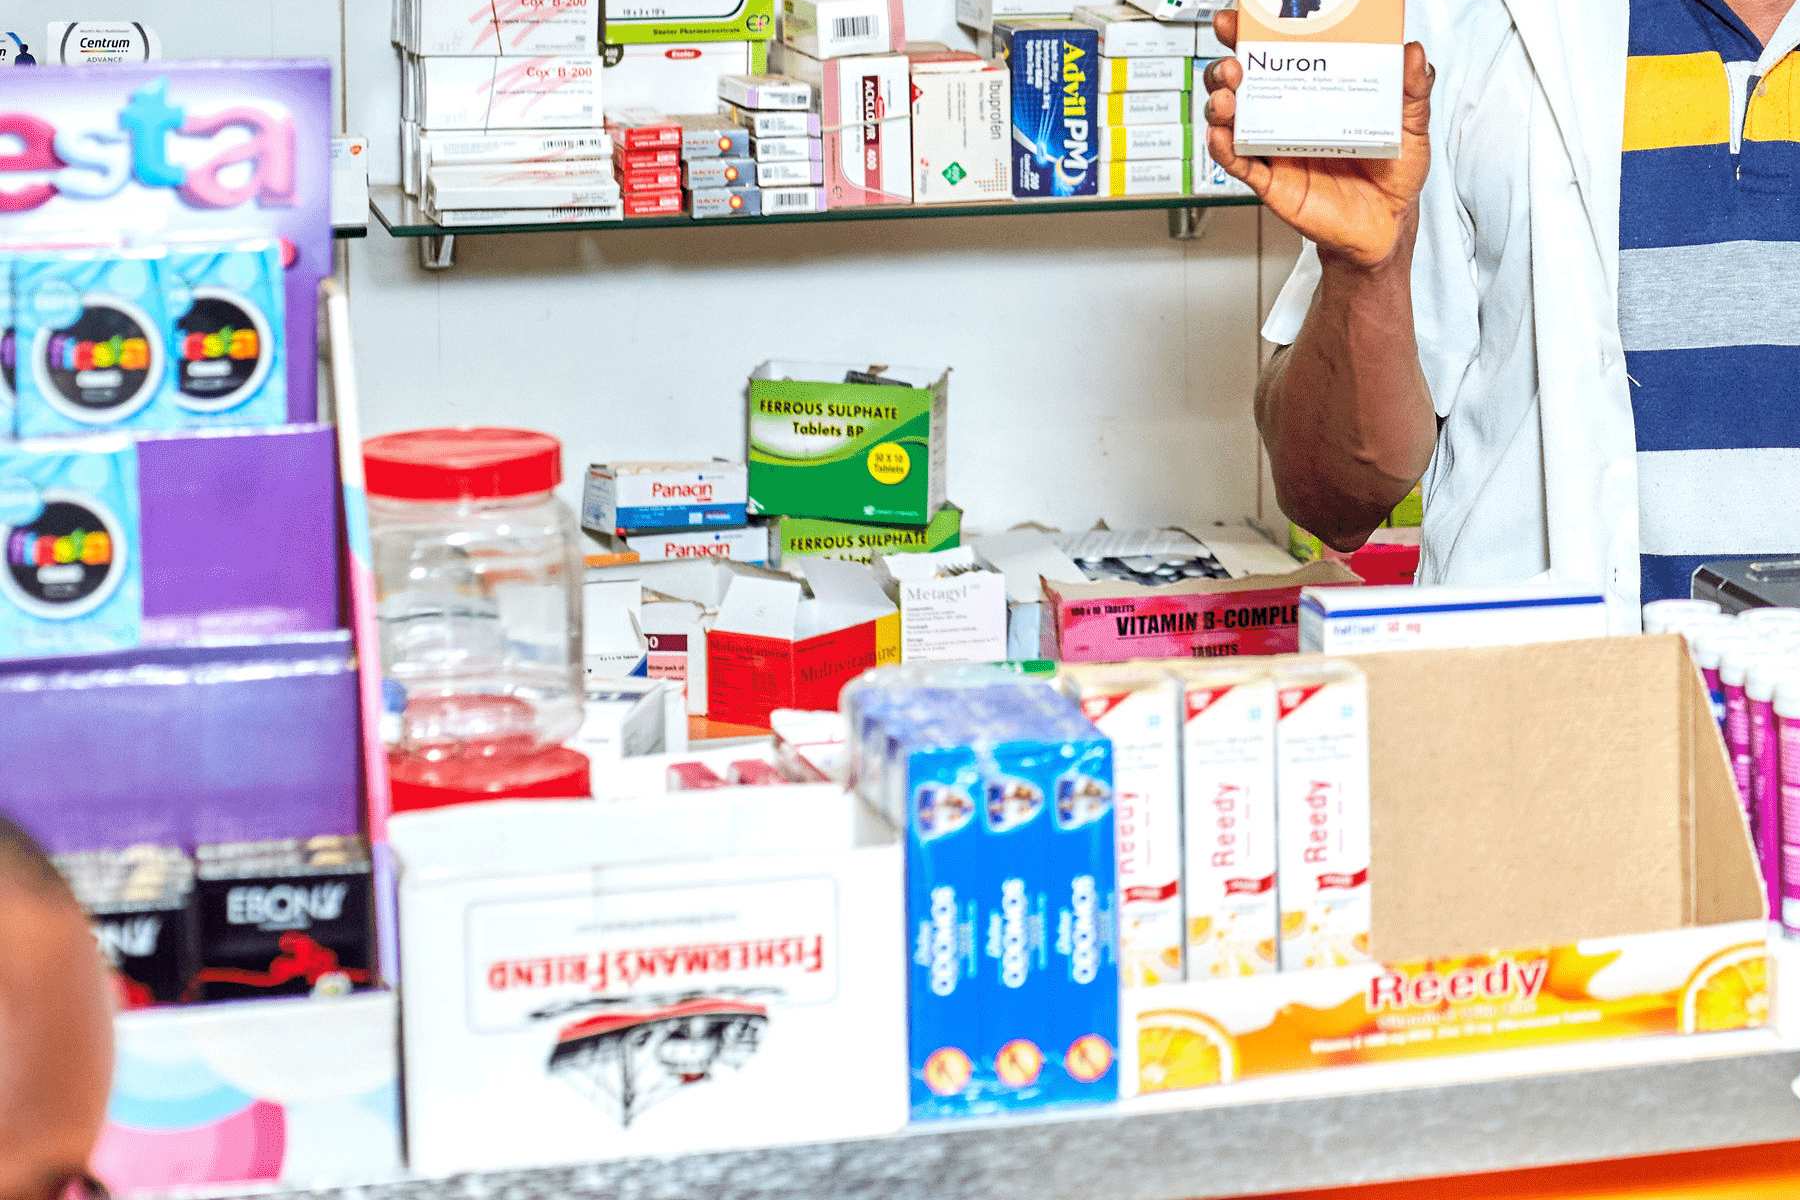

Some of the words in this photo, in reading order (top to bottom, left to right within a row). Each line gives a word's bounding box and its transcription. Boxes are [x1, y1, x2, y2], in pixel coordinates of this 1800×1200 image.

[80, 37, 130, 50] Centrum
[1248, 51, 1327, 73] Nuron
[1063, 40, 1083, 115] Advil
[990, 79, 1002, 140] Ibuprofen
[1064, 117, 1088, 185] PM
[759, 399, 823, 418] FERROUS
[827, 402, 898, 421] SULPHATE
[792, 421, 843, 438] Tablets
[846, 424, 865, 438] BP
[651, 481, 713, 498] Panacin
[664, 541, 731, 558] Panacin
[790, 535, 853, 552] FERROUS
[857, 531, 928, 548] SULPHATE
[906, 586, 968, 602] Metagyl
[1116, 614, 1197, 637] VITAMIN
[1211, 781, 1242, 869] Reedy
[1303, 779, 1333, 865] Reedy
[487, 949, 610, 992] FRIEND
[1367, 955, 1549, 1012] Reedy
